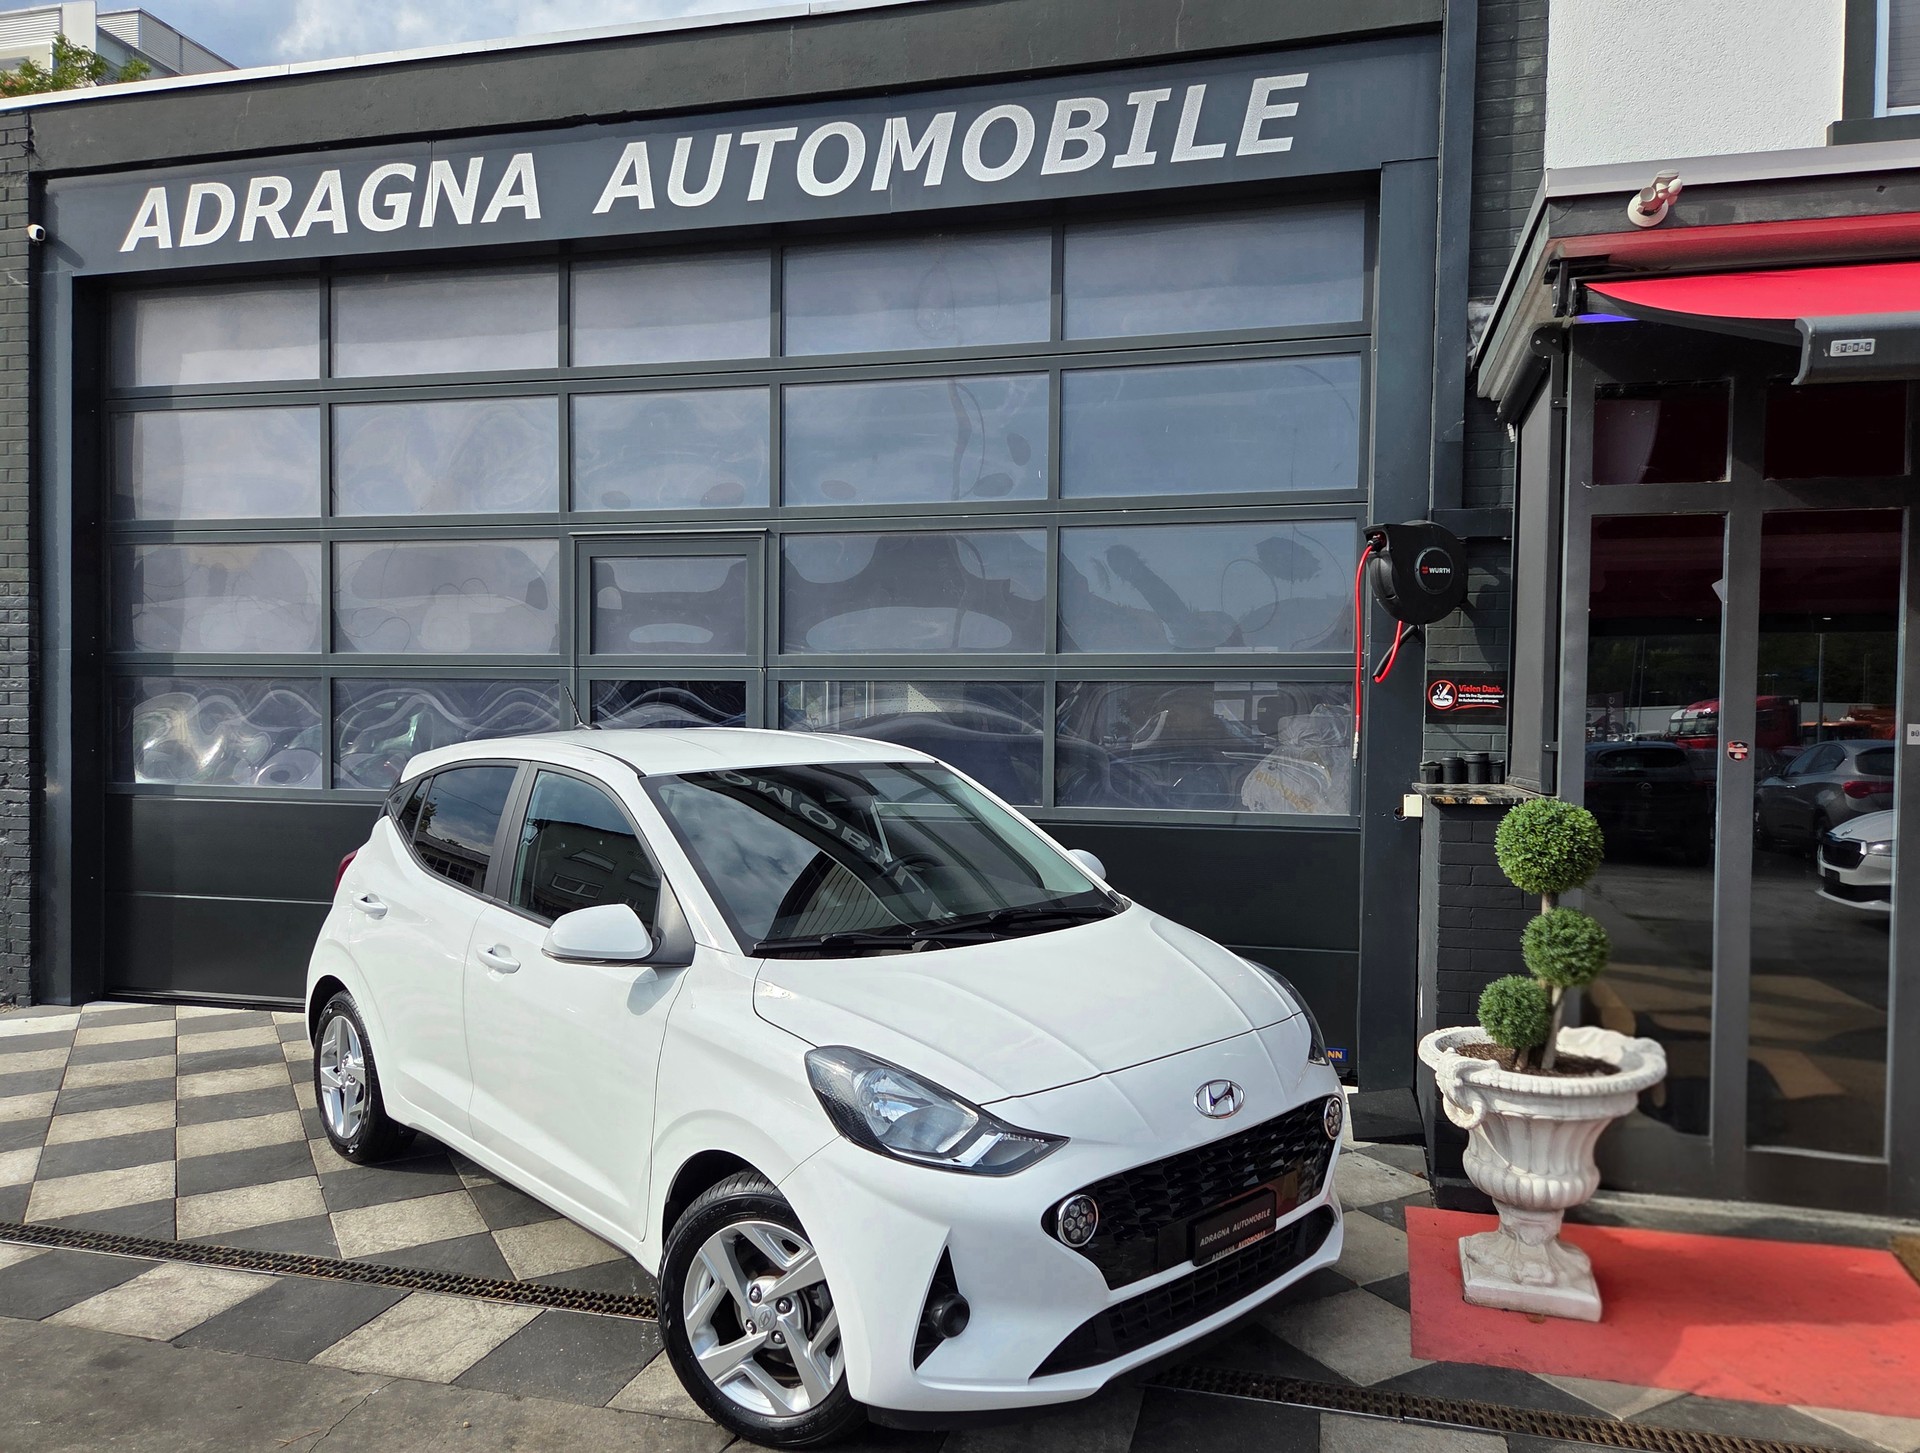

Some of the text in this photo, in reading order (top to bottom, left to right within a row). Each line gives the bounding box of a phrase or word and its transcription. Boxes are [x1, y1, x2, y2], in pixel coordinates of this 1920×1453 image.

[119, 73, 1309, 252] ADRAGNA AUTOMOBILE
[1200, 1208, 1271, 1247] ADRAGNA AUTOMOBILE
